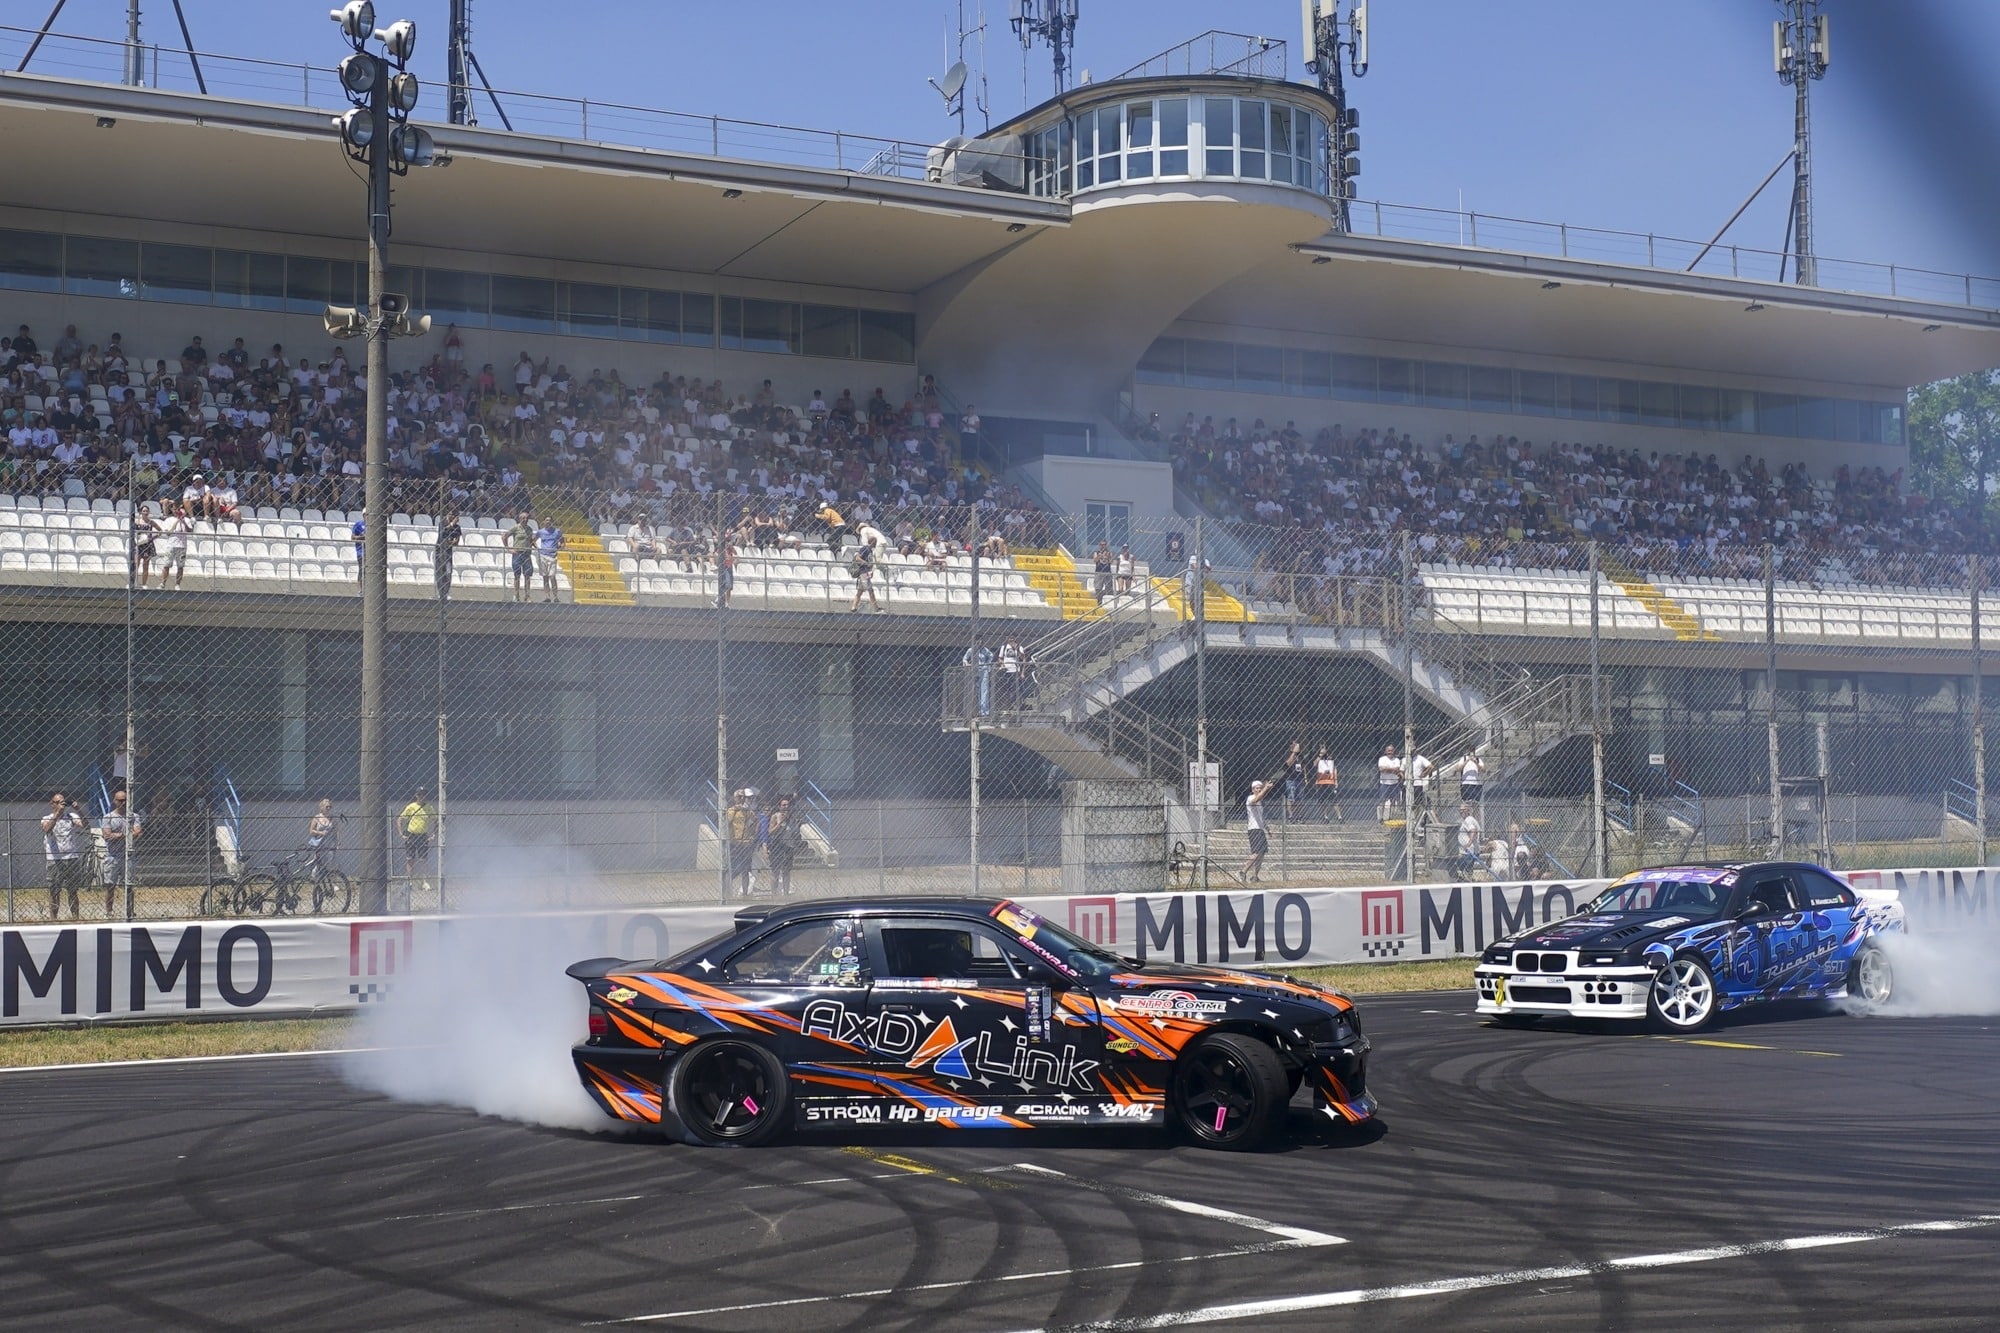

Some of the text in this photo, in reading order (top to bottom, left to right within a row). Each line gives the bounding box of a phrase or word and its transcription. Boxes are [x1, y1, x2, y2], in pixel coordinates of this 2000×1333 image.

[1135, 893, 1312, 964] MIMO
[2, 924, 273, 1018] MIMO
[820, 964, 839, 974] E 85
[1120, 998, 1227, 1011] CENTRO GOMME
[1138, 1010, 1204, 1020] PISTOIA
[1107, 1041, 1138, 1049] SUNOCO
[975, 1030, 1100, 1092] Link
[806, 1102, 881, 1120] STRÖM
[888, 1105, 1004, 1122] Hp garage
